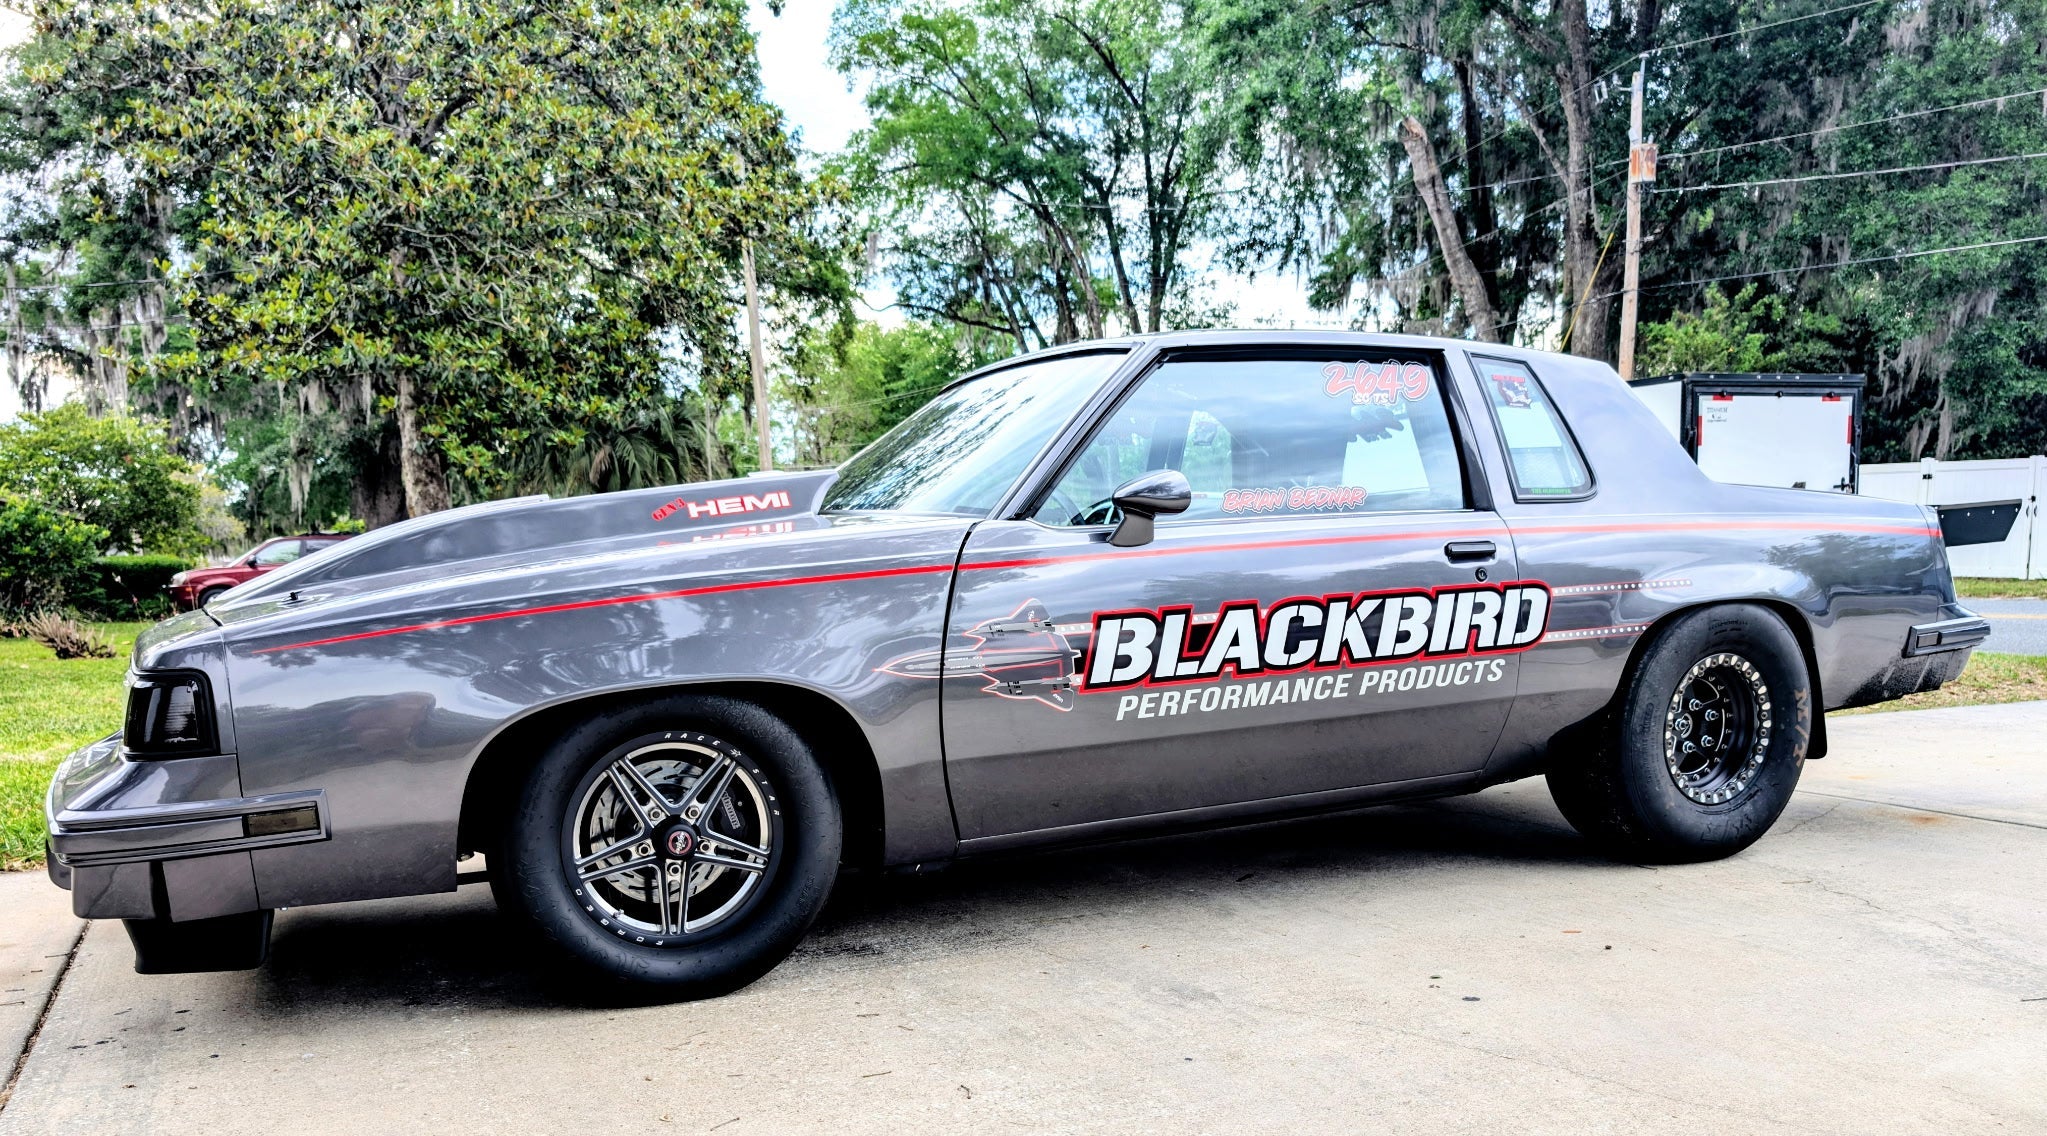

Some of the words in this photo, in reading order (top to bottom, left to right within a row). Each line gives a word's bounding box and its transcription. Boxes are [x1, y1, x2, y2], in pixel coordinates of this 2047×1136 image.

[1321, 359, 1430, 402] 2649
[652, 502, 677, 521] GEN
[675, 497, 686, 509] 3
[686, 491, 791, 519] HEMI
[1222, 488, 1287, 514] BRIAN
[1287, 486, 1368, 510] BEDNAR
[1084, 583, 1551, 688] BLACKBIRD
[1116, 672, 1353, 721] PERFORMANCE
[1358, 659, 1507, 695] PRODUCTS
[664, 732, 721, 747] RACE
[752, 768, 781, 817] STAR
[575, 888, 664, 946] FORGED
